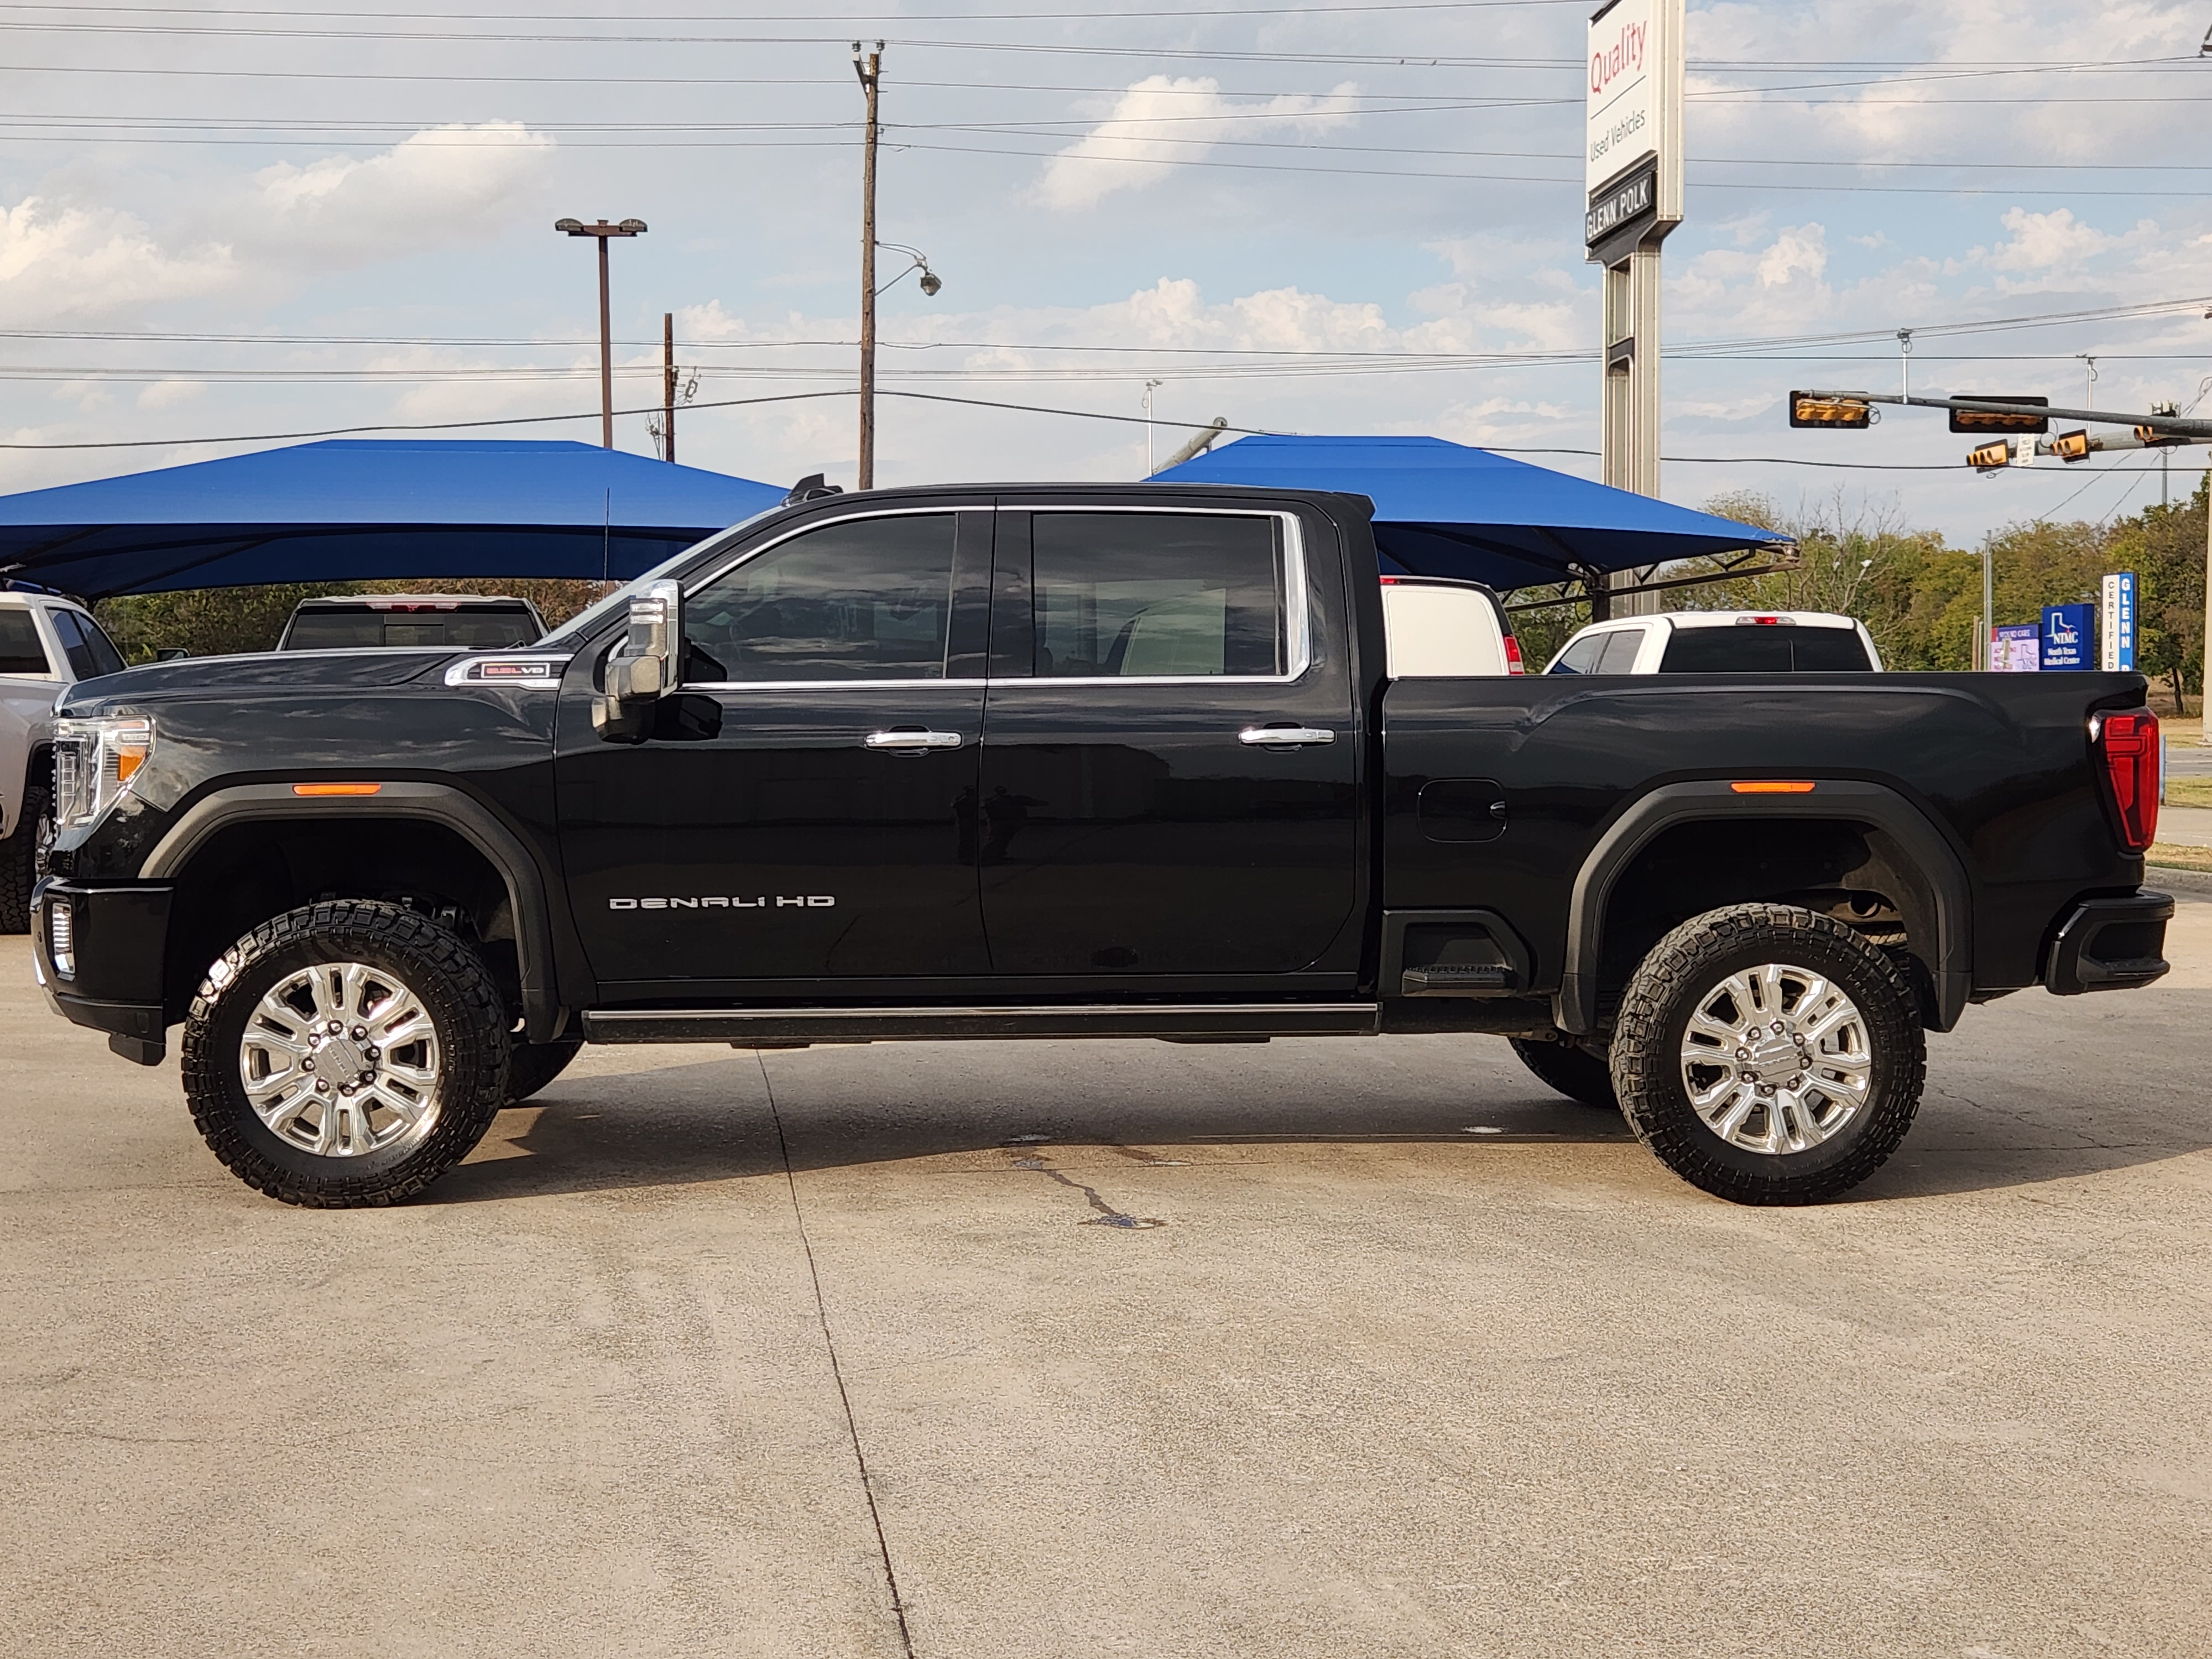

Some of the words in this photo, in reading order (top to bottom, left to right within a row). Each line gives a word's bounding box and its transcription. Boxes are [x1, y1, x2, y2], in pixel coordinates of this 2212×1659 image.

[1590, 20, 1647, 95] Quality
[1590, 130, 1610, 161] Used
[1611, 109, 1646, 147] Vehicles
[1586, 198, 1617, 239] GLENN
[1619, 178, 1648, 218] POLK
[2121, 578, 2131, 649] GLENN
[609, 897, 765, 910] DENALI
[776, 896, 835, 907] HD
